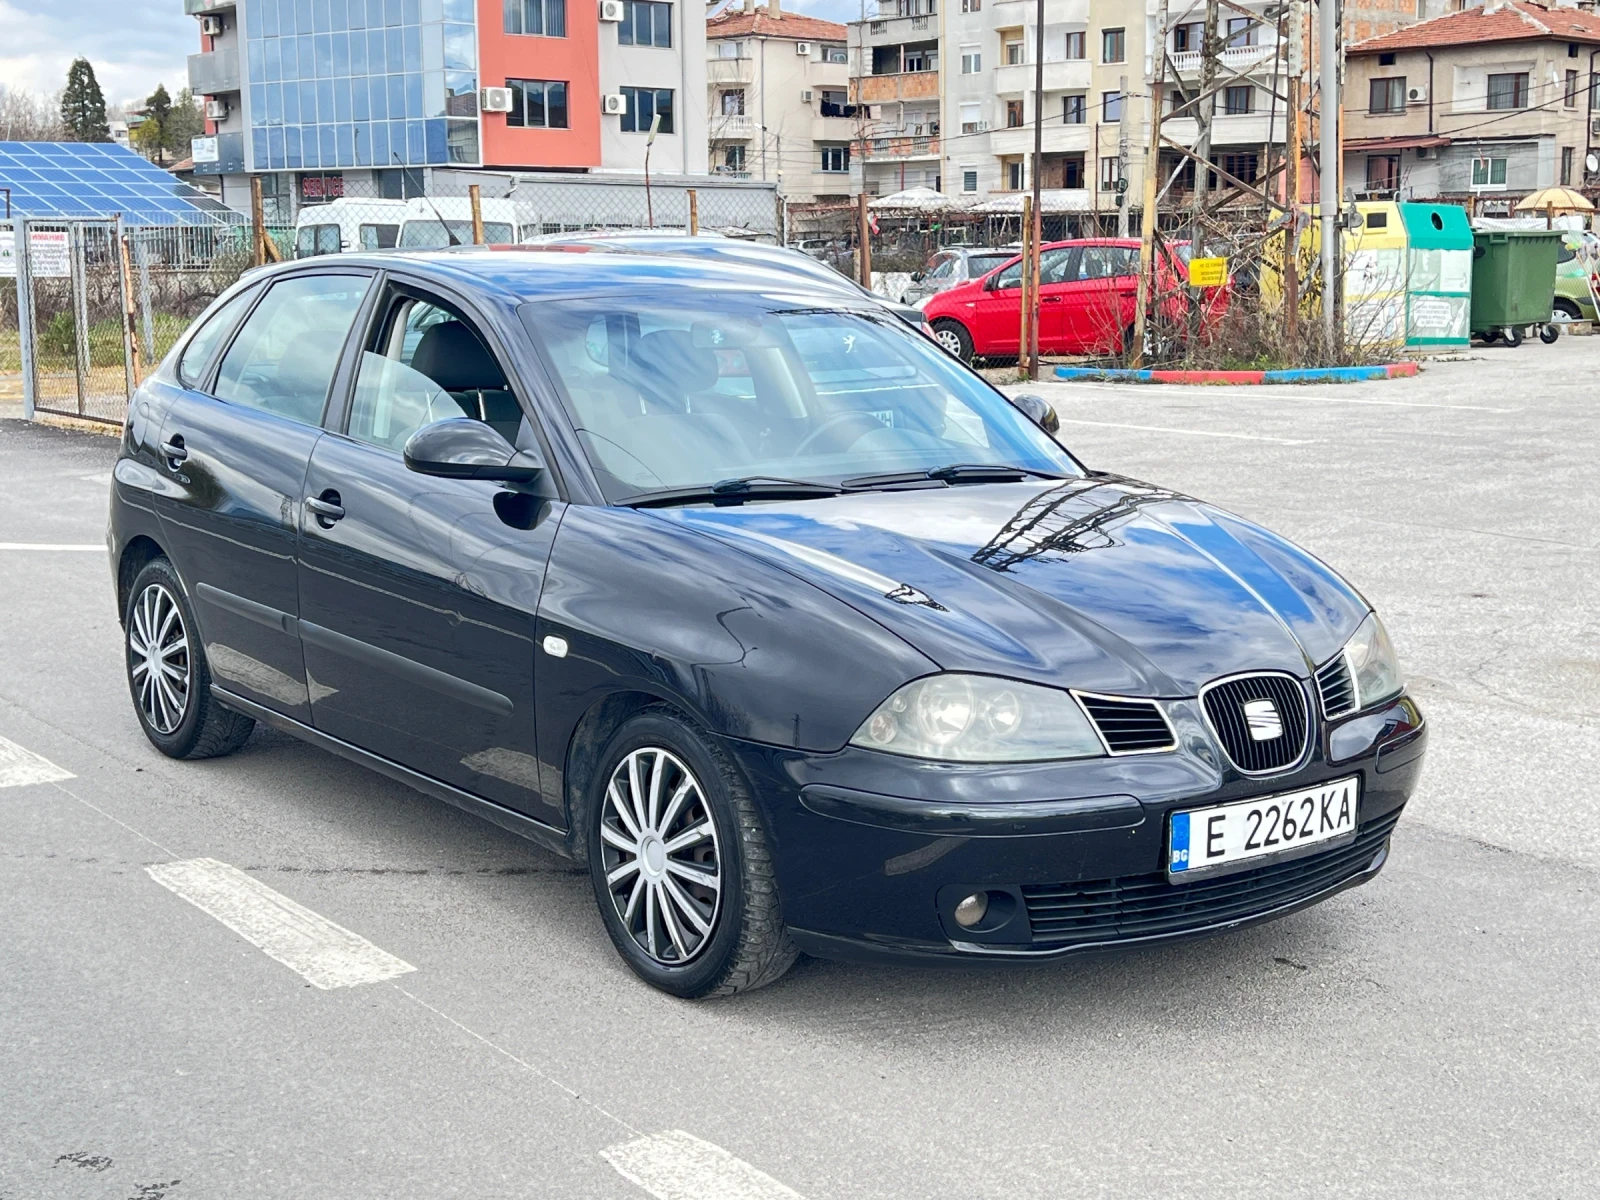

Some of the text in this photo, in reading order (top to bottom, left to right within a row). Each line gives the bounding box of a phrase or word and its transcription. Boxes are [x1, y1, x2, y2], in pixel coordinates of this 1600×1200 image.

[303, 177, 344, 197] SERVICE
[1206, 787, 1351, 859] E 2262KA
[1172, 850, 1188, 863] BG
